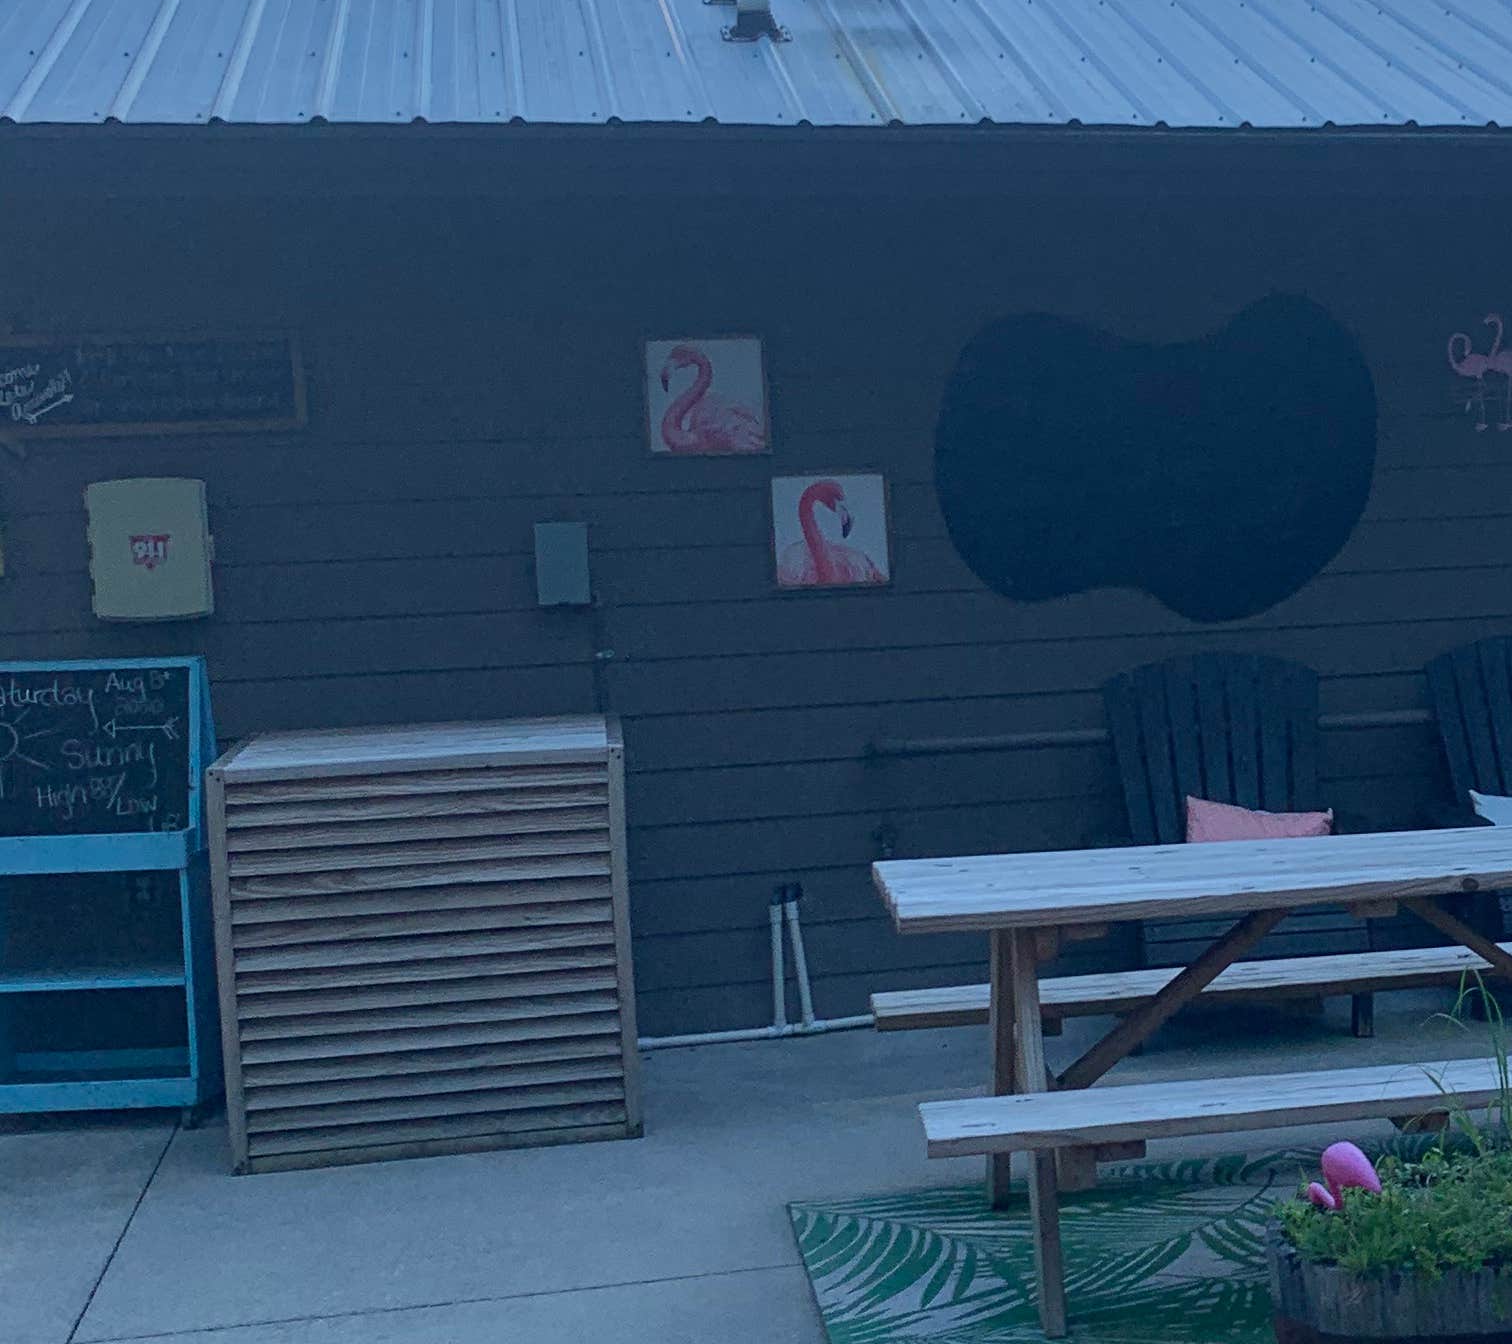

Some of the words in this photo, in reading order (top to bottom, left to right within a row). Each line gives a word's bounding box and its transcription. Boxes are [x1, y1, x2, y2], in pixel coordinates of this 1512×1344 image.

[105, 672, 146, 701] Aug
[61, 739, 157, 789] Sunny
[36, 783, 87, 821] High
